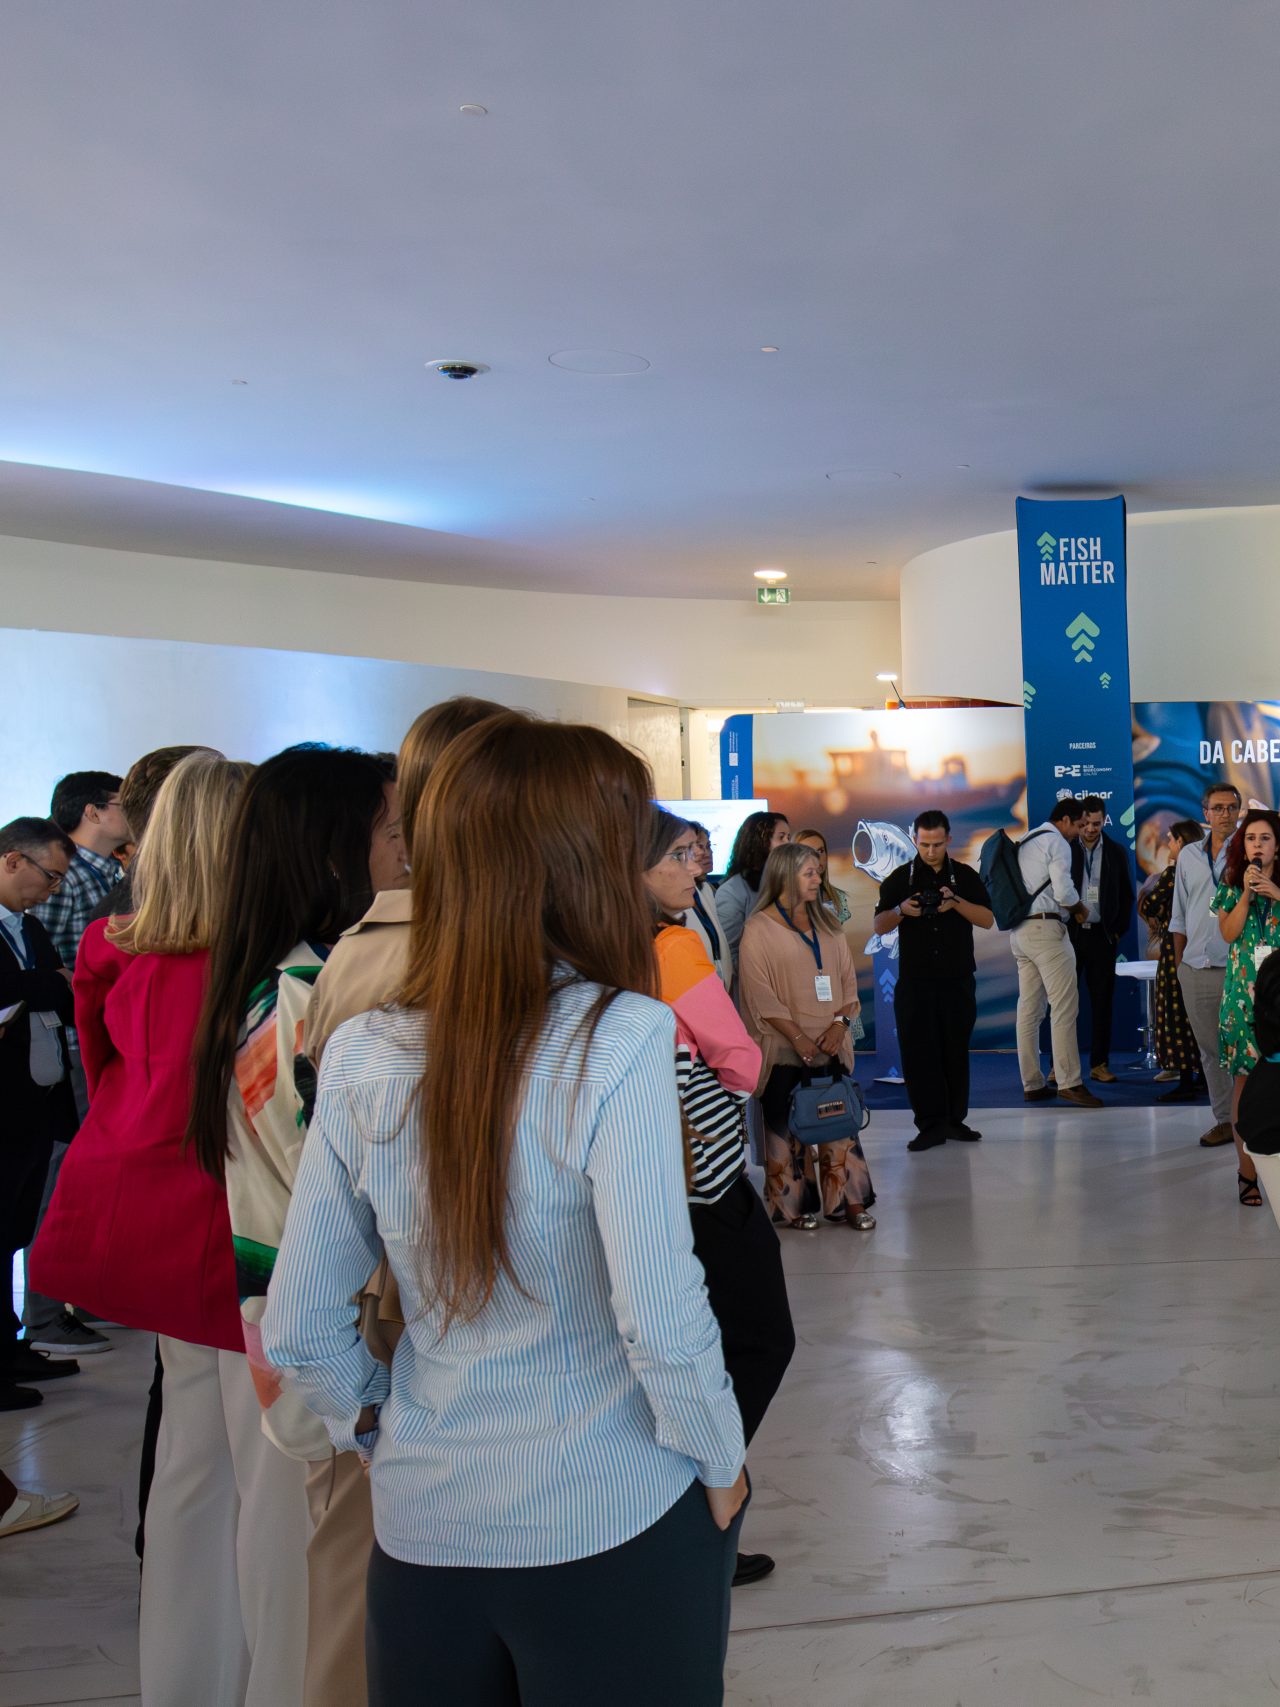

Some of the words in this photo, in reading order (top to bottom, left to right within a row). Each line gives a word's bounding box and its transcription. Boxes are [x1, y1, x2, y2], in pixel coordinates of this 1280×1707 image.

[1059, 537, 1102, 561] FISH
[1040, 560, 1115, 586] MATTER
[1069, 742, 1097, 750] PARCEIROS
[1199, 740, 1225, 764] DA
